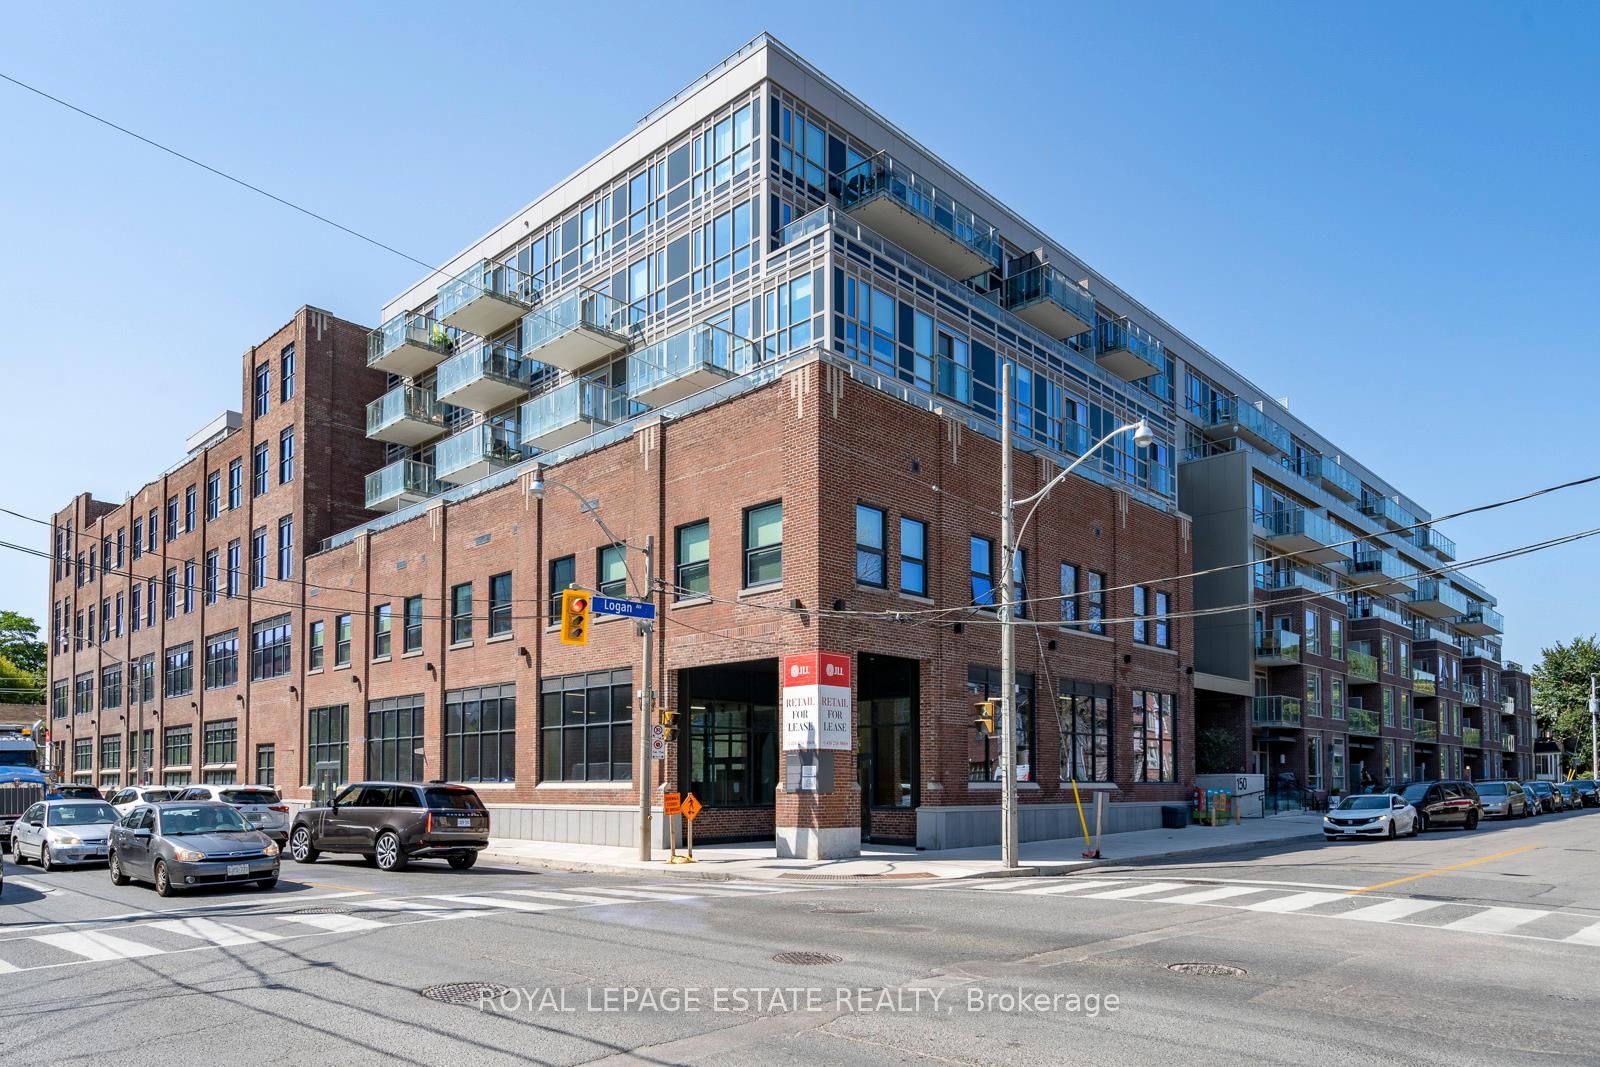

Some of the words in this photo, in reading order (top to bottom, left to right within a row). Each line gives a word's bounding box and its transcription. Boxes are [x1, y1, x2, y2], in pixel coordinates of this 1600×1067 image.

[604, 600, 632, 614] Logan
[786, 697, 815, 708] RETAIL
[821, 696, 848, 708] RETAIL
[792, 710, 808, 719] FOR
[827, 710, 843, 719] FOR
[788, 722, 813, 732] LEASE
[823, 721, 847, 732] LEASE
